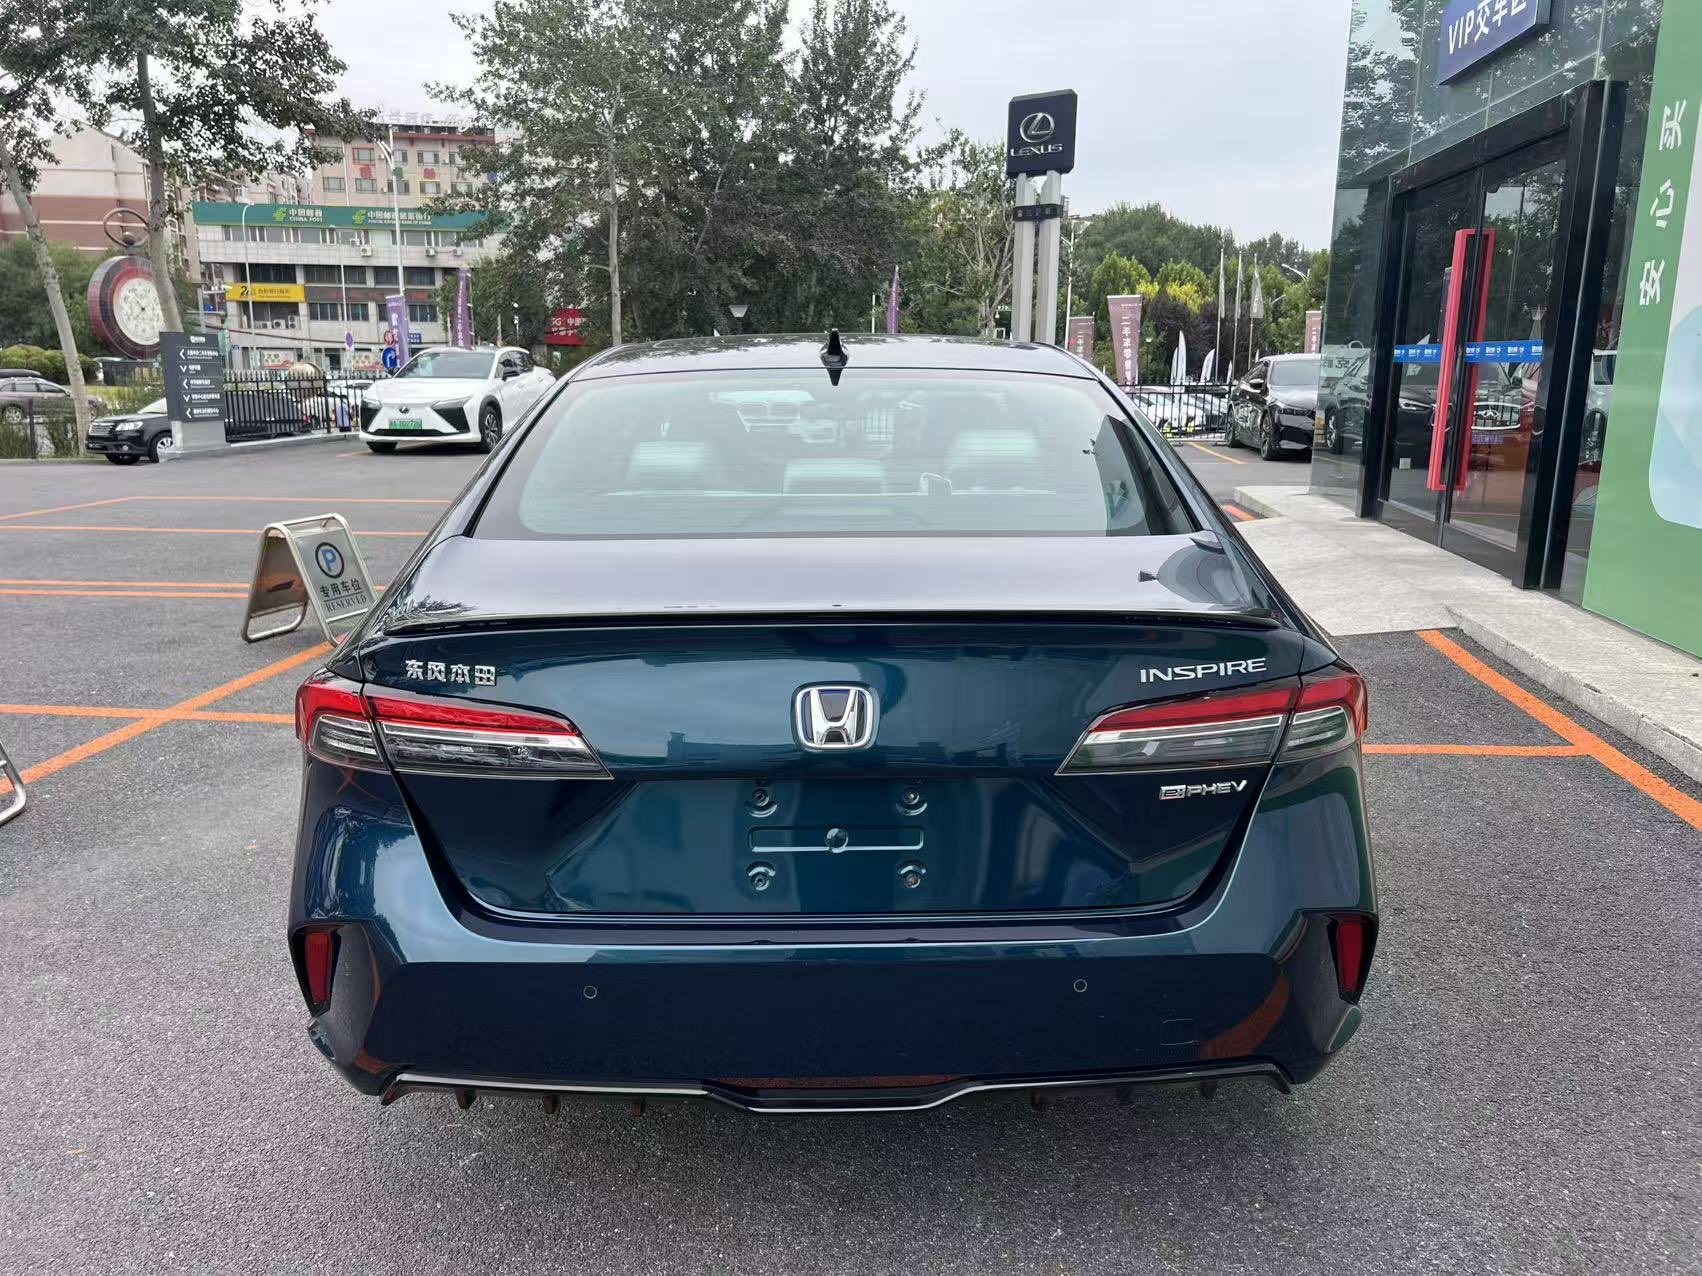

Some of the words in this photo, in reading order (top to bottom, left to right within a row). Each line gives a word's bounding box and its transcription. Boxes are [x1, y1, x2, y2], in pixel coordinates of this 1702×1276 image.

[1010, 143, 1063, 157] LEXUS
[319, 577, 363, 598] 专用车位
[325, 595, 368, 613] RESERVED
[405, 659, 496, 686] 东风本田
[1140, 657, 1267, 683] INSPIRE
